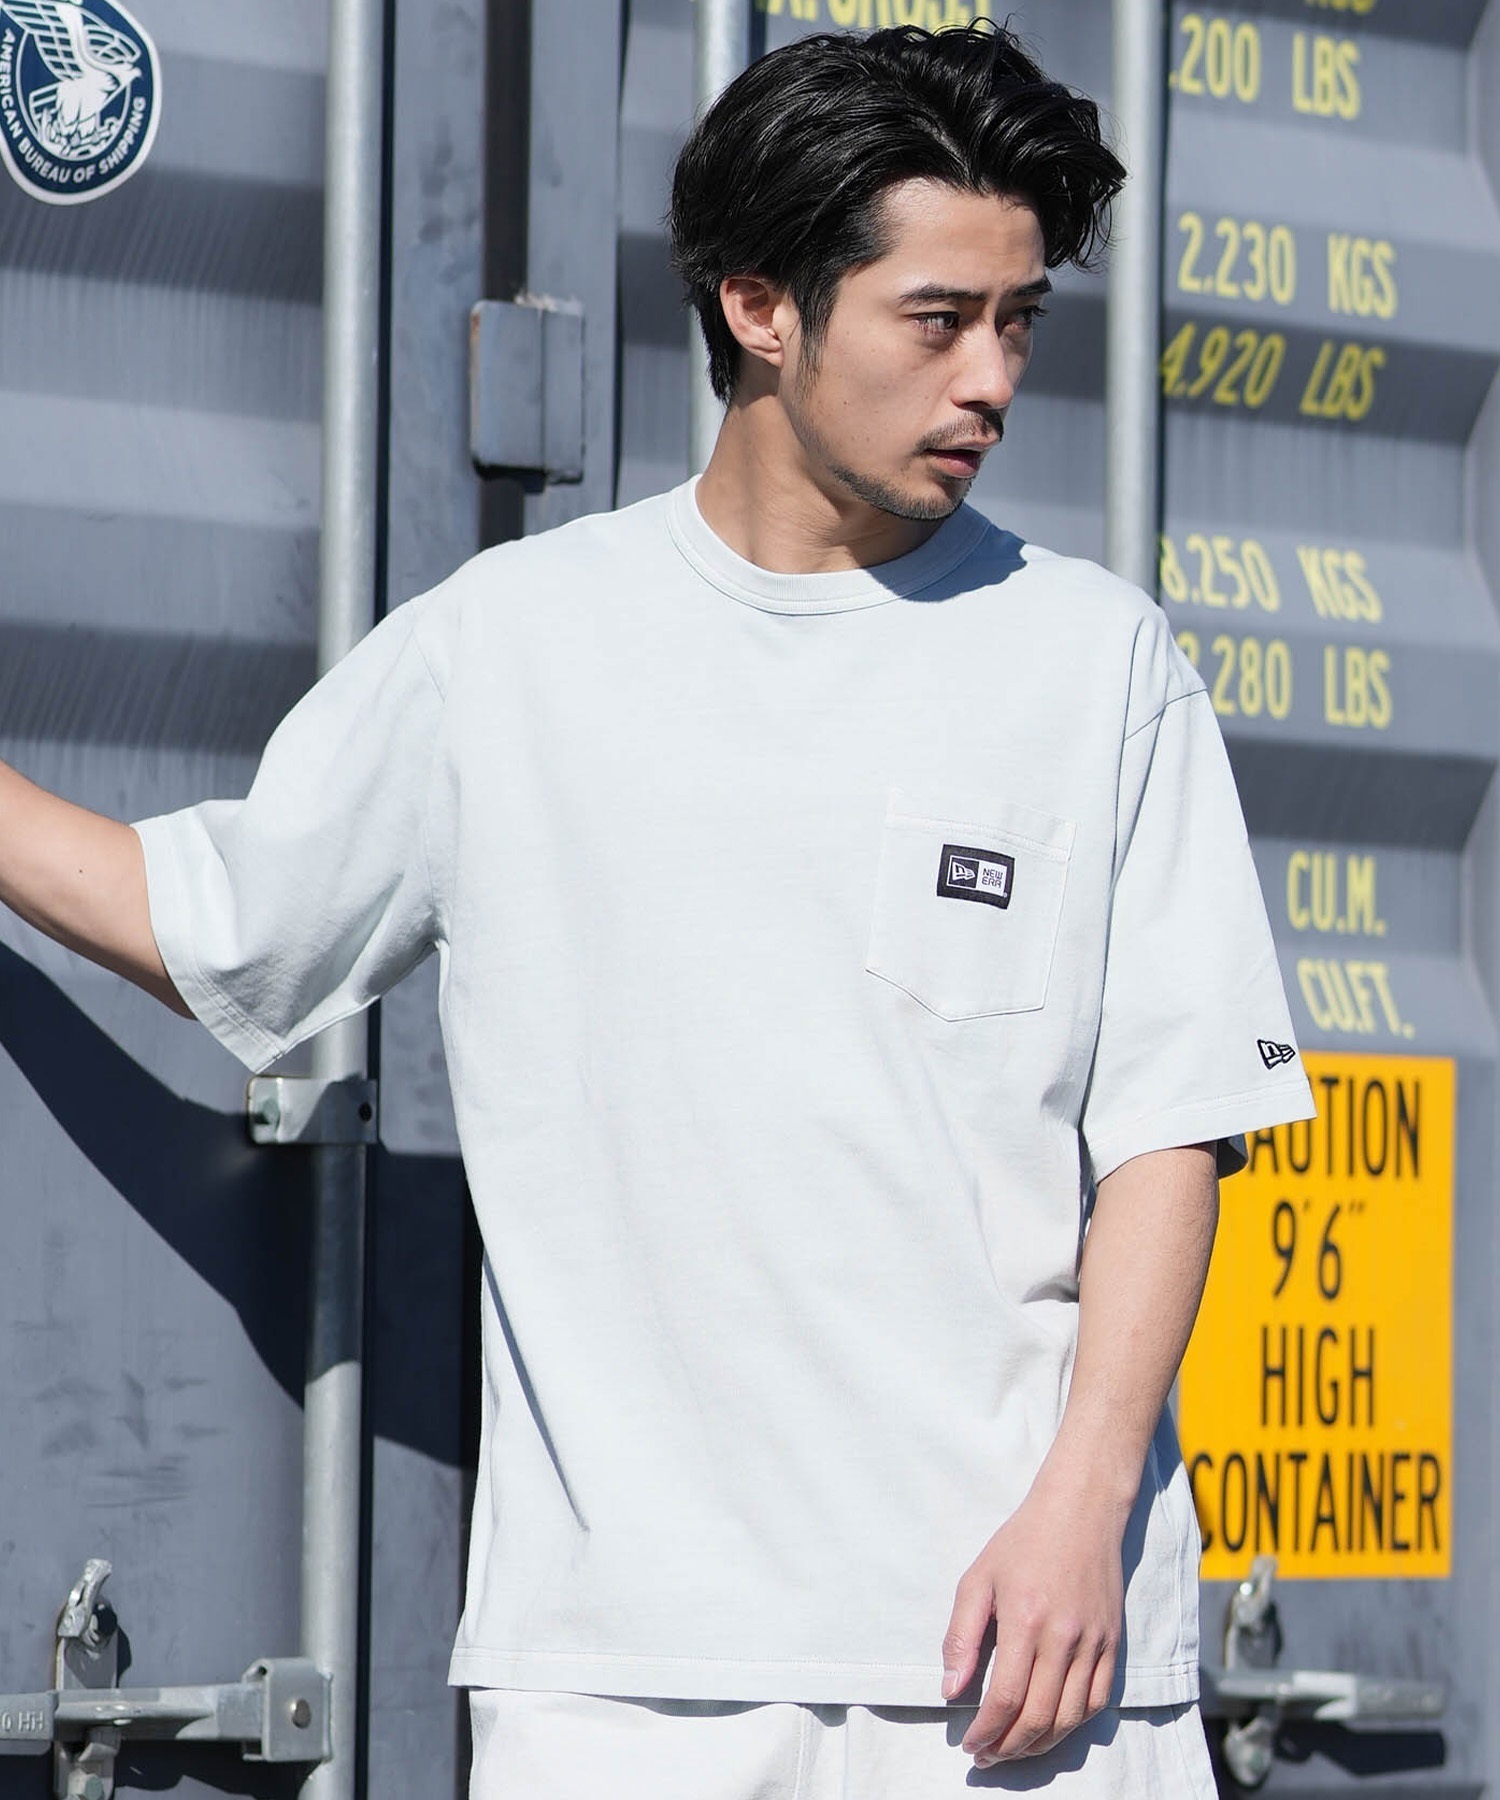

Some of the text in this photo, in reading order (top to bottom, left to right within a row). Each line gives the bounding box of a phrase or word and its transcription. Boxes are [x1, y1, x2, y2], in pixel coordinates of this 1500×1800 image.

[0, 28, 146, 184] AMERICAN BUREAU OF SHIPPING
[1292, 32, 1361, 119] LBS
[1178, 212, 1396, 318] 2.230 KGS
[1300, 341, 1386, 420] LBS
[1297, 545, 1383, 623] KGS
[1324, 644, 1391, 728] LBS
[981, 877, 1002, 889] ERA
[982, 868, 1004, 880] NEW
[1287, 851, 1386, 936] CU.M.
[1249, 1076, 1420, 1178] AUTION
[1261, 1325, 1375, 1428] HIGH
[1191, 1452, 1442, 1554] CONTAINER
